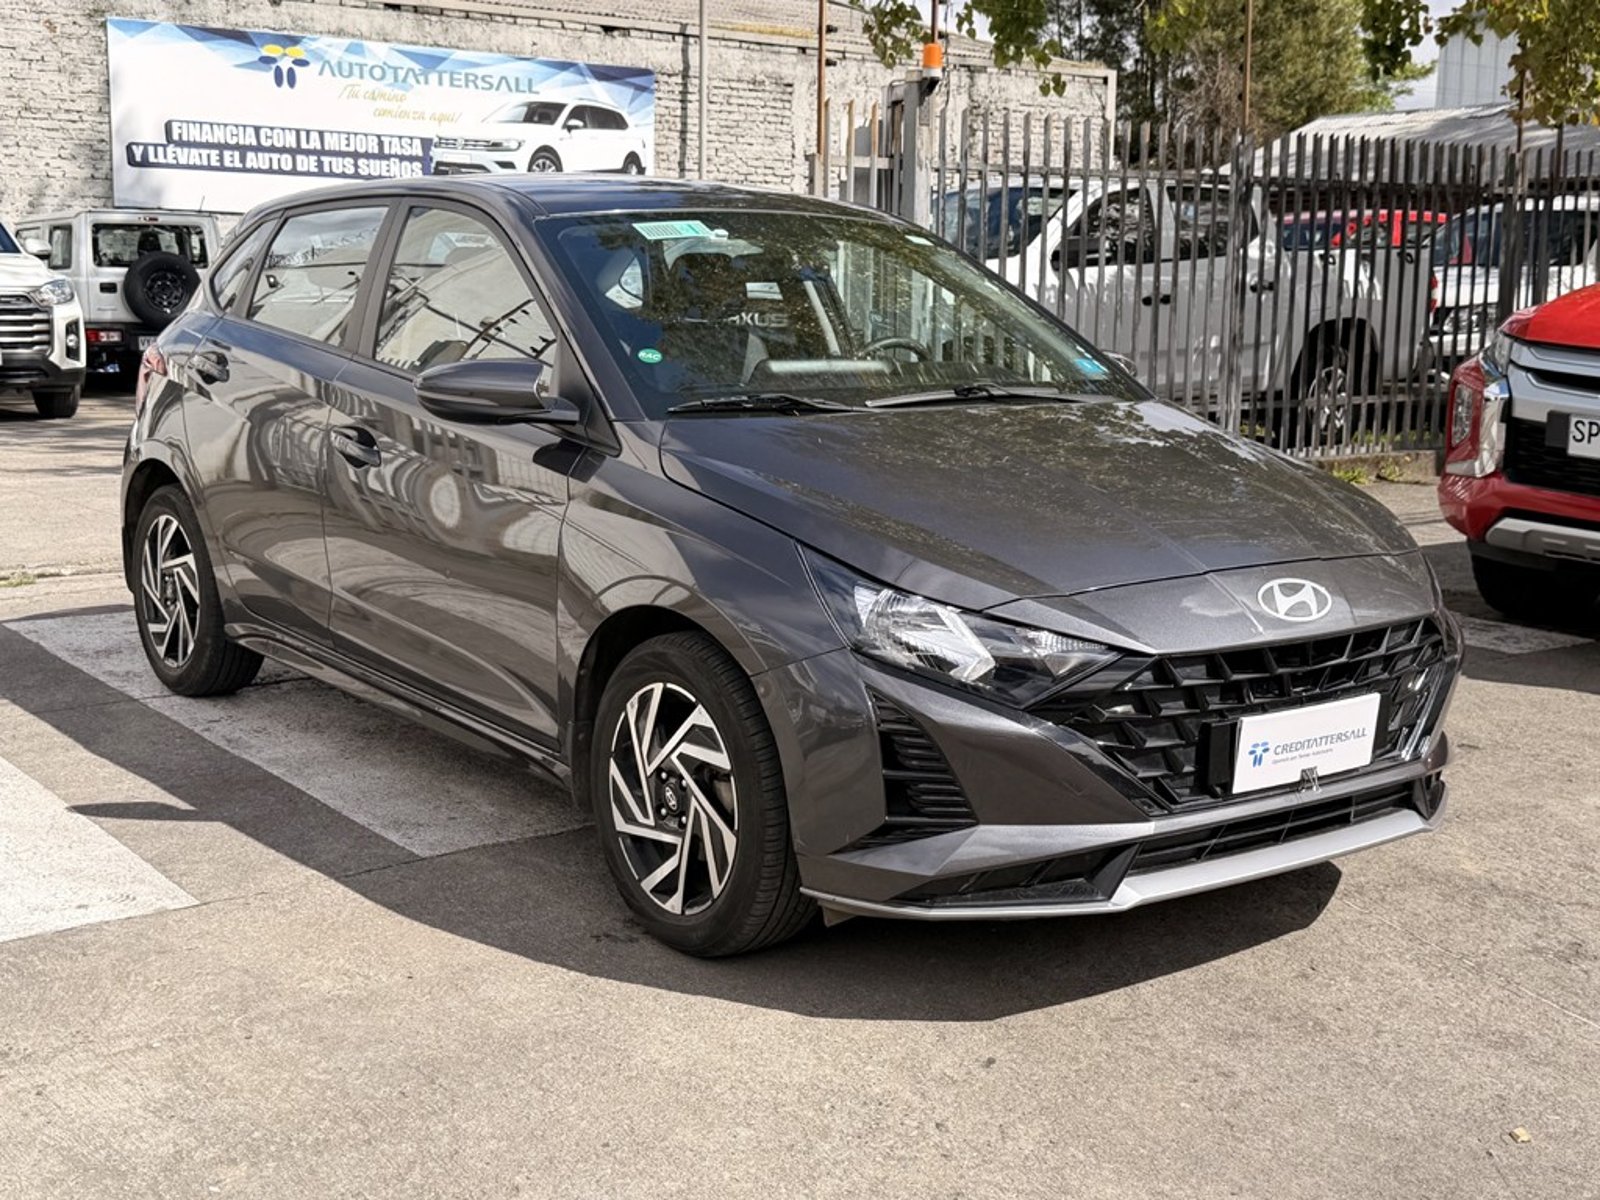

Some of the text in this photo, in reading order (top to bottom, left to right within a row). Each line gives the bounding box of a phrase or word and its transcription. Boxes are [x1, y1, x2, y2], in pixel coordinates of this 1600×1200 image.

[318, 59, 540, 95] AUTOTATTERSALL
[171, 121, 423, 157] FINANCIA CON LA MEJOR TASA
[131, 143, 423, 178] Y LLÉVATE EL AUTO DE TUS SUEÑOS
[1273, 727, 1368, 756] CREDITATTERSALL
